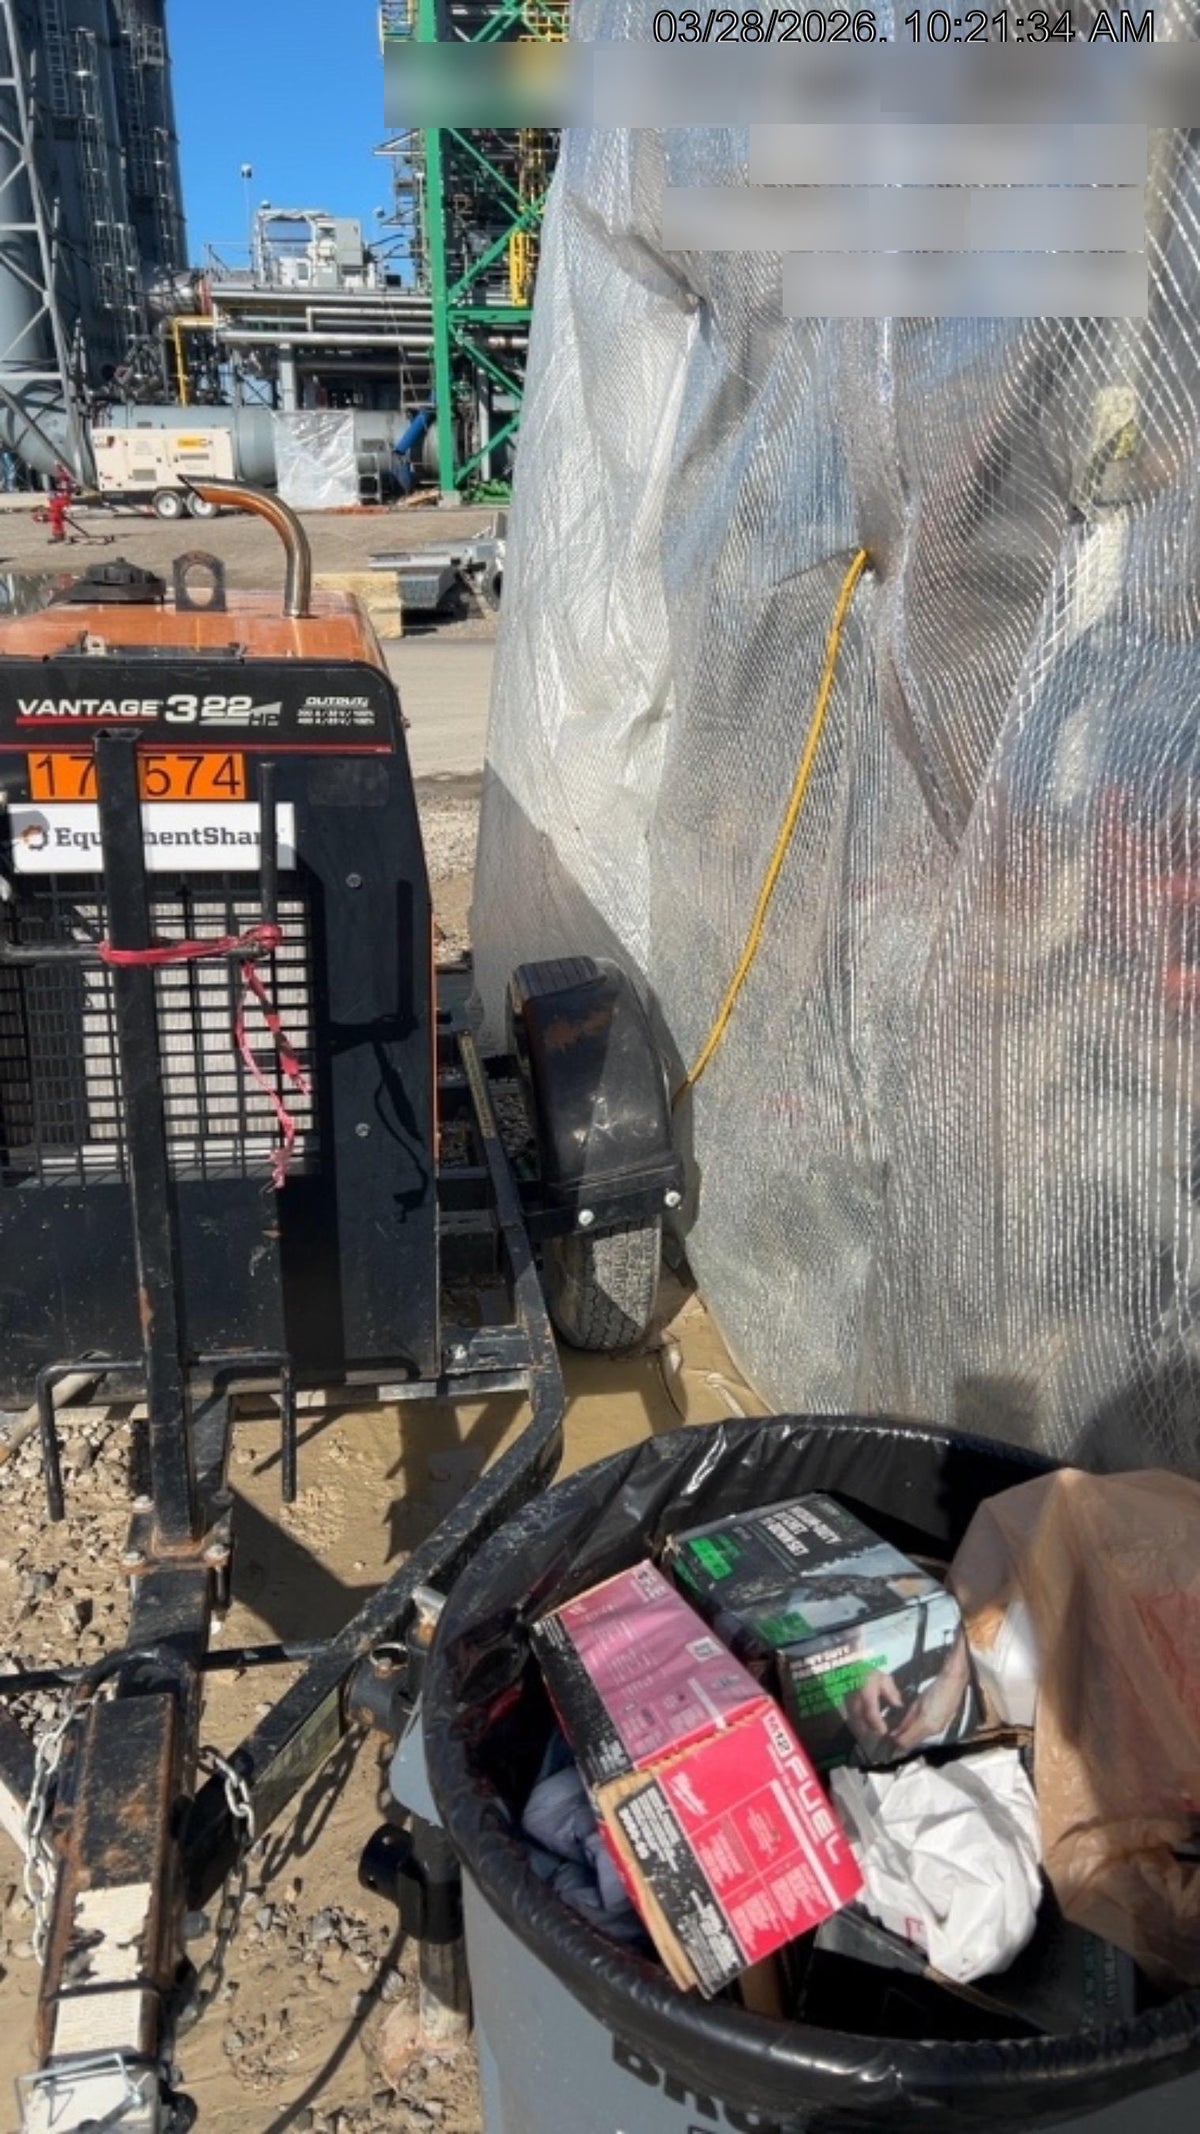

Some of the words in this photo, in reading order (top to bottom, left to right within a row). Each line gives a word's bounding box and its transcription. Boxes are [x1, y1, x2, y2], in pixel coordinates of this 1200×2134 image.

[17, 699, 159, 716] VANTAGE
[165, 694, 252, 722] 322
[36, 755, 240, 796] 17574
[54, 827, 277, 851] EqumentShar
[784, 1755, 840, 1865] FUEL
